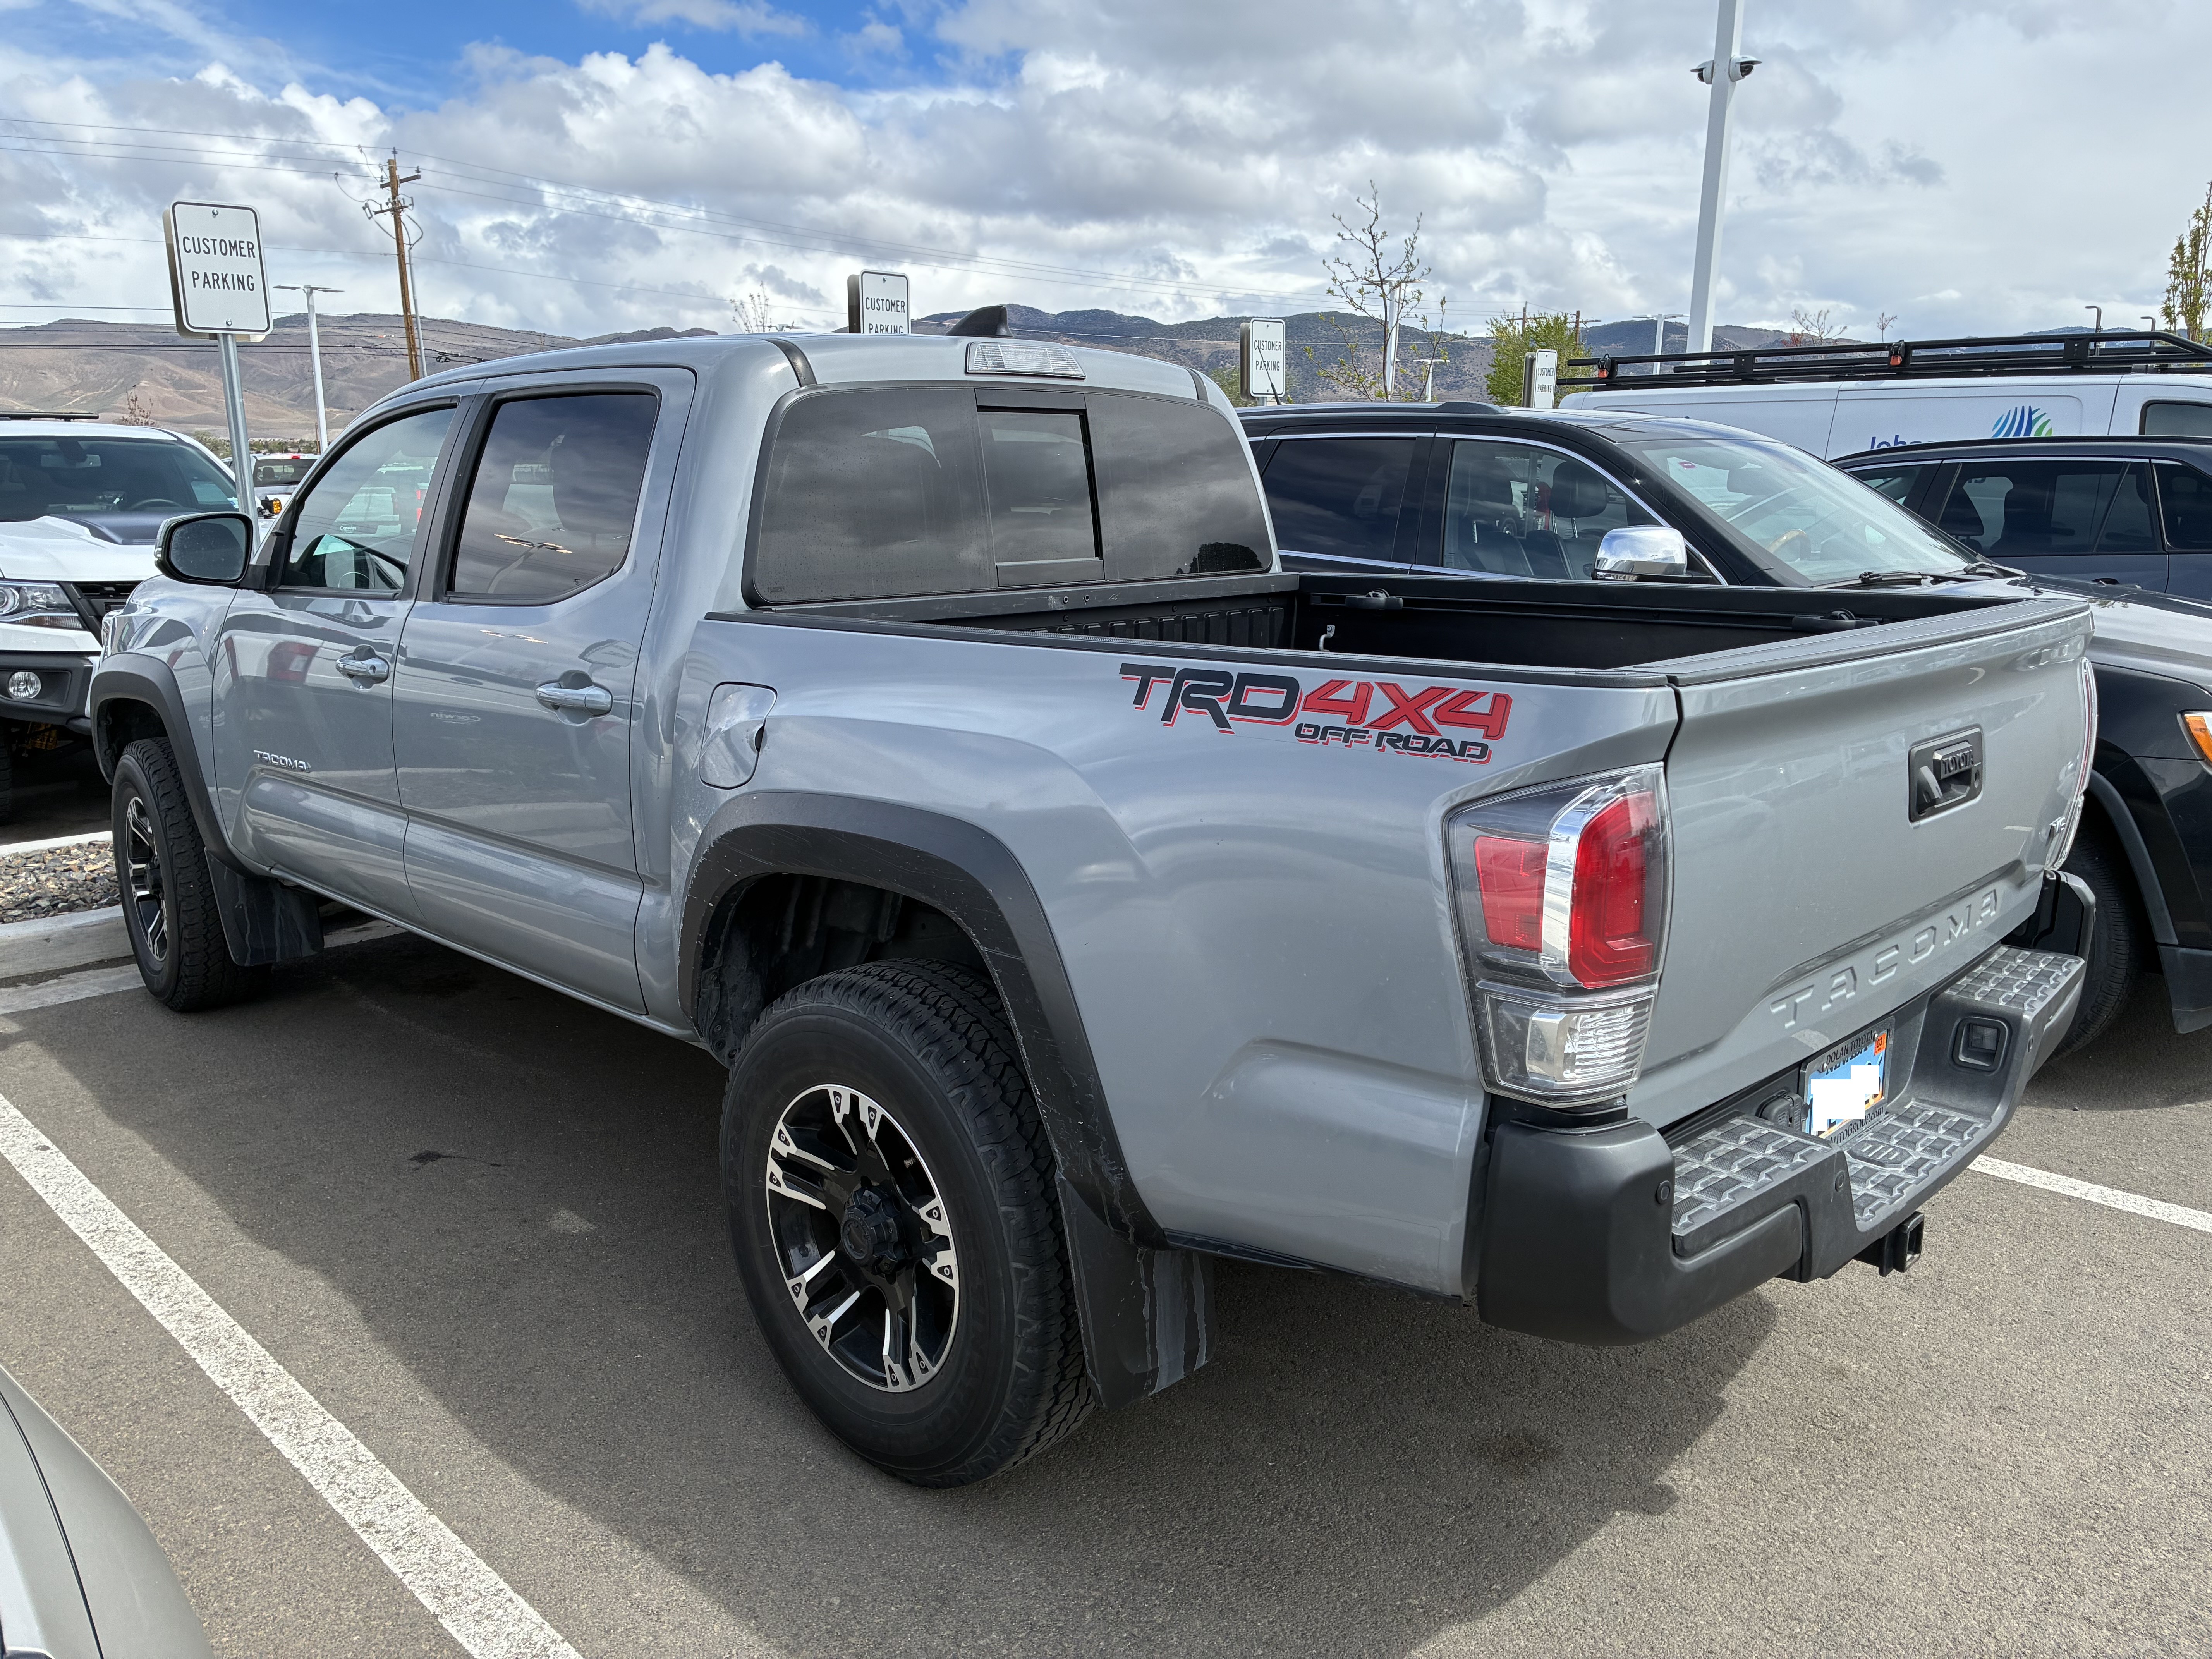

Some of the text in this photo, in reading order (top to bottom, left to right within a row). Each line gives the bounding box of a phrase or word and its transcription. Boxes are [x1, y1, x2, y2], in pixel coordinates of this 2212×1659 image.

[182, 236, 256, 258] CUSTOMER
[192, 271, 255, 292] PARKING
[865, 297, 905, 313] CUSTOMER
[869, 323, 903, 334] PARKING
[1254, 340, 1281, 351] CUSTOMER
[1255, 360, 1280, 371] PARKING
[1537, 367, 1554, 376] CUSTOMER
[1537, 384, 1552, 393] PARKING
[1119, 663, 1303, 735] TRD
[1294, 723, 1493, 766] OFF ROAD
[253, 750, 311, 773] TACOMA
[1942, 749, 1974, 775] TOYOTA
[1769, 888, 1998, 1029] TACOMA
[1826, 1043, 1849, 1065] DOLAN
[1850, 1029, 1873, 1052] TOYOTA
